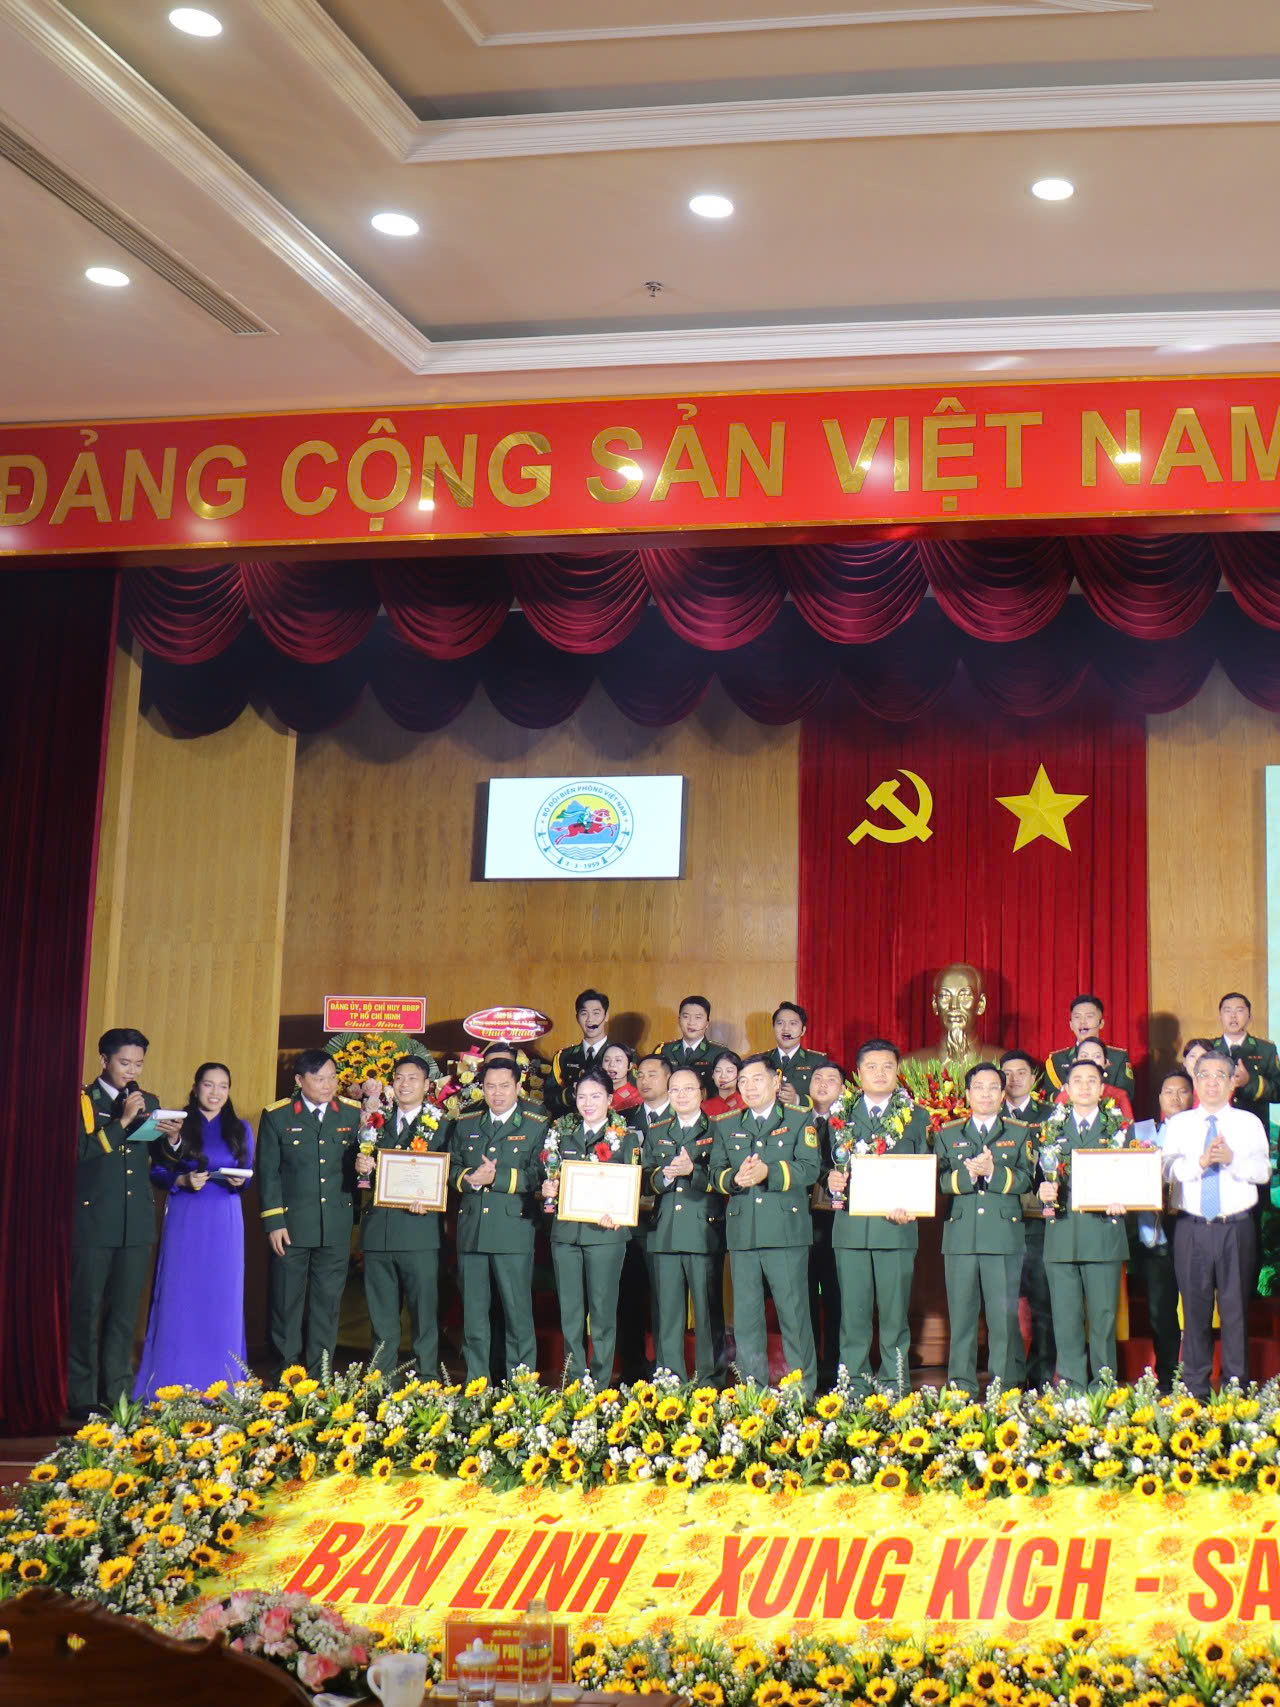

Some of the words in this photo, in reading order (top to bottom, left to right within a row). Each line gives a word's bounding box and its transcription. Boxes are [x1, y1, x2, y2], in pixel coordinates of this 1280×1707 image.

[0, 429, 248, 527] ĐẢNG
[281, 418, 553, 532] CỘNG
[586, 403, 786, 503] SẢN
[822, 397, 1043, 512] VIỆT
[283, 1498, 469, 1606] BẢN
[447, 1513, 648, 1613] LĨNH
[690, 1535, 914, 1620] XUNG
[926, 1520, 1111, 1620] KÍCH
